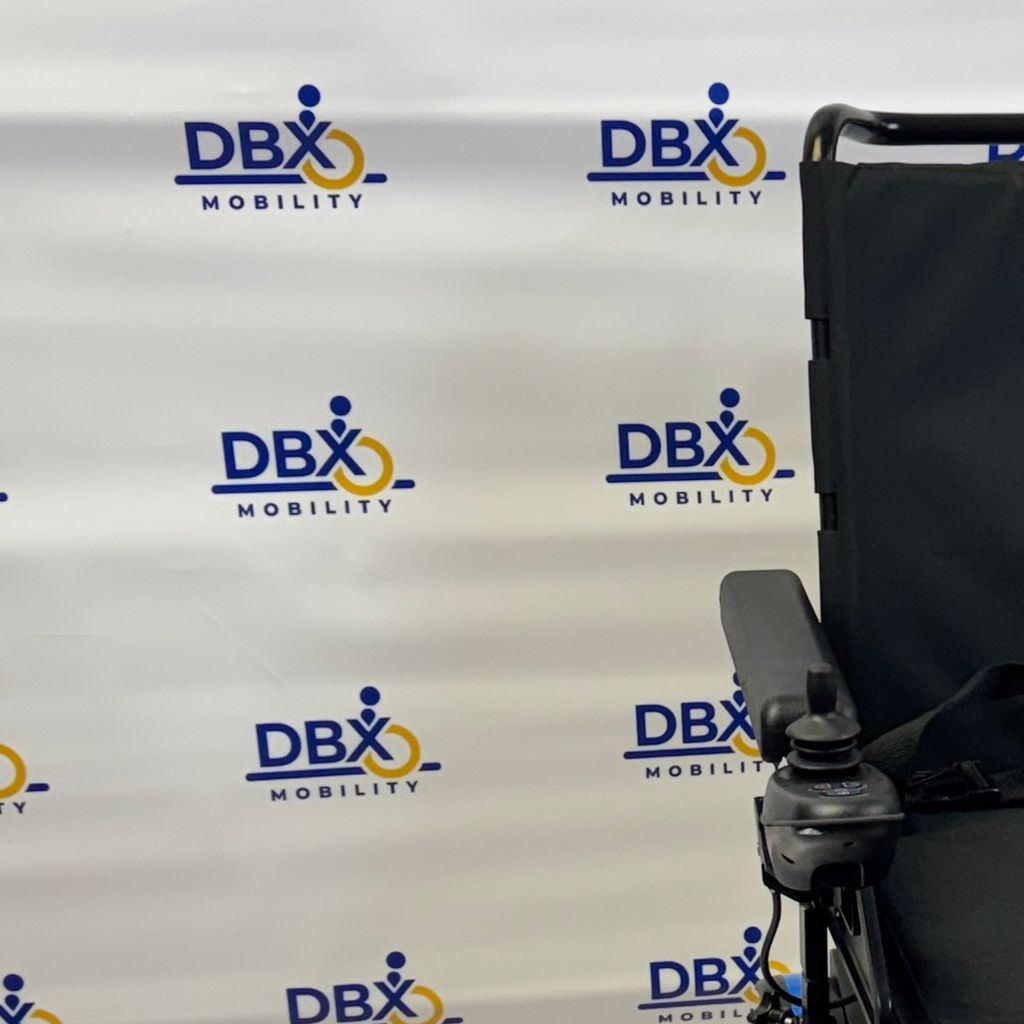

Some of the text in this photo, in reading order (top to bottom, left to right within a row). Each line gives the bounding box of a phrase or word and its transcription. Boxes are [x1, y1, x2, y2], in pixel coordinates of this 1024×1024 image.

[184, 118, 336, 170] DBX
[601, 116, 739, 168] DBX
[202, 194, 362, 210] MOBILITY
[611, 190, 761, 206] MOBILITY
[221, 426, 366, 479] DBX
[618, 418, 750, 469] DBX
[238, 499, 391, 518] MOBILITY
[630, 489, 772, 506] MOBILITY
[255, 714, 394, 768] DBX
[635, 701, 757, 747] DBX
[270, 780, 418, 801] MOBILITY
[646, 760, 763, 780] MOBILIT
[649, 955, 760, 1000] DBX
[286, 979, 418, 1024] DBX
[659, 1008, 743, 1023] MOBIL
